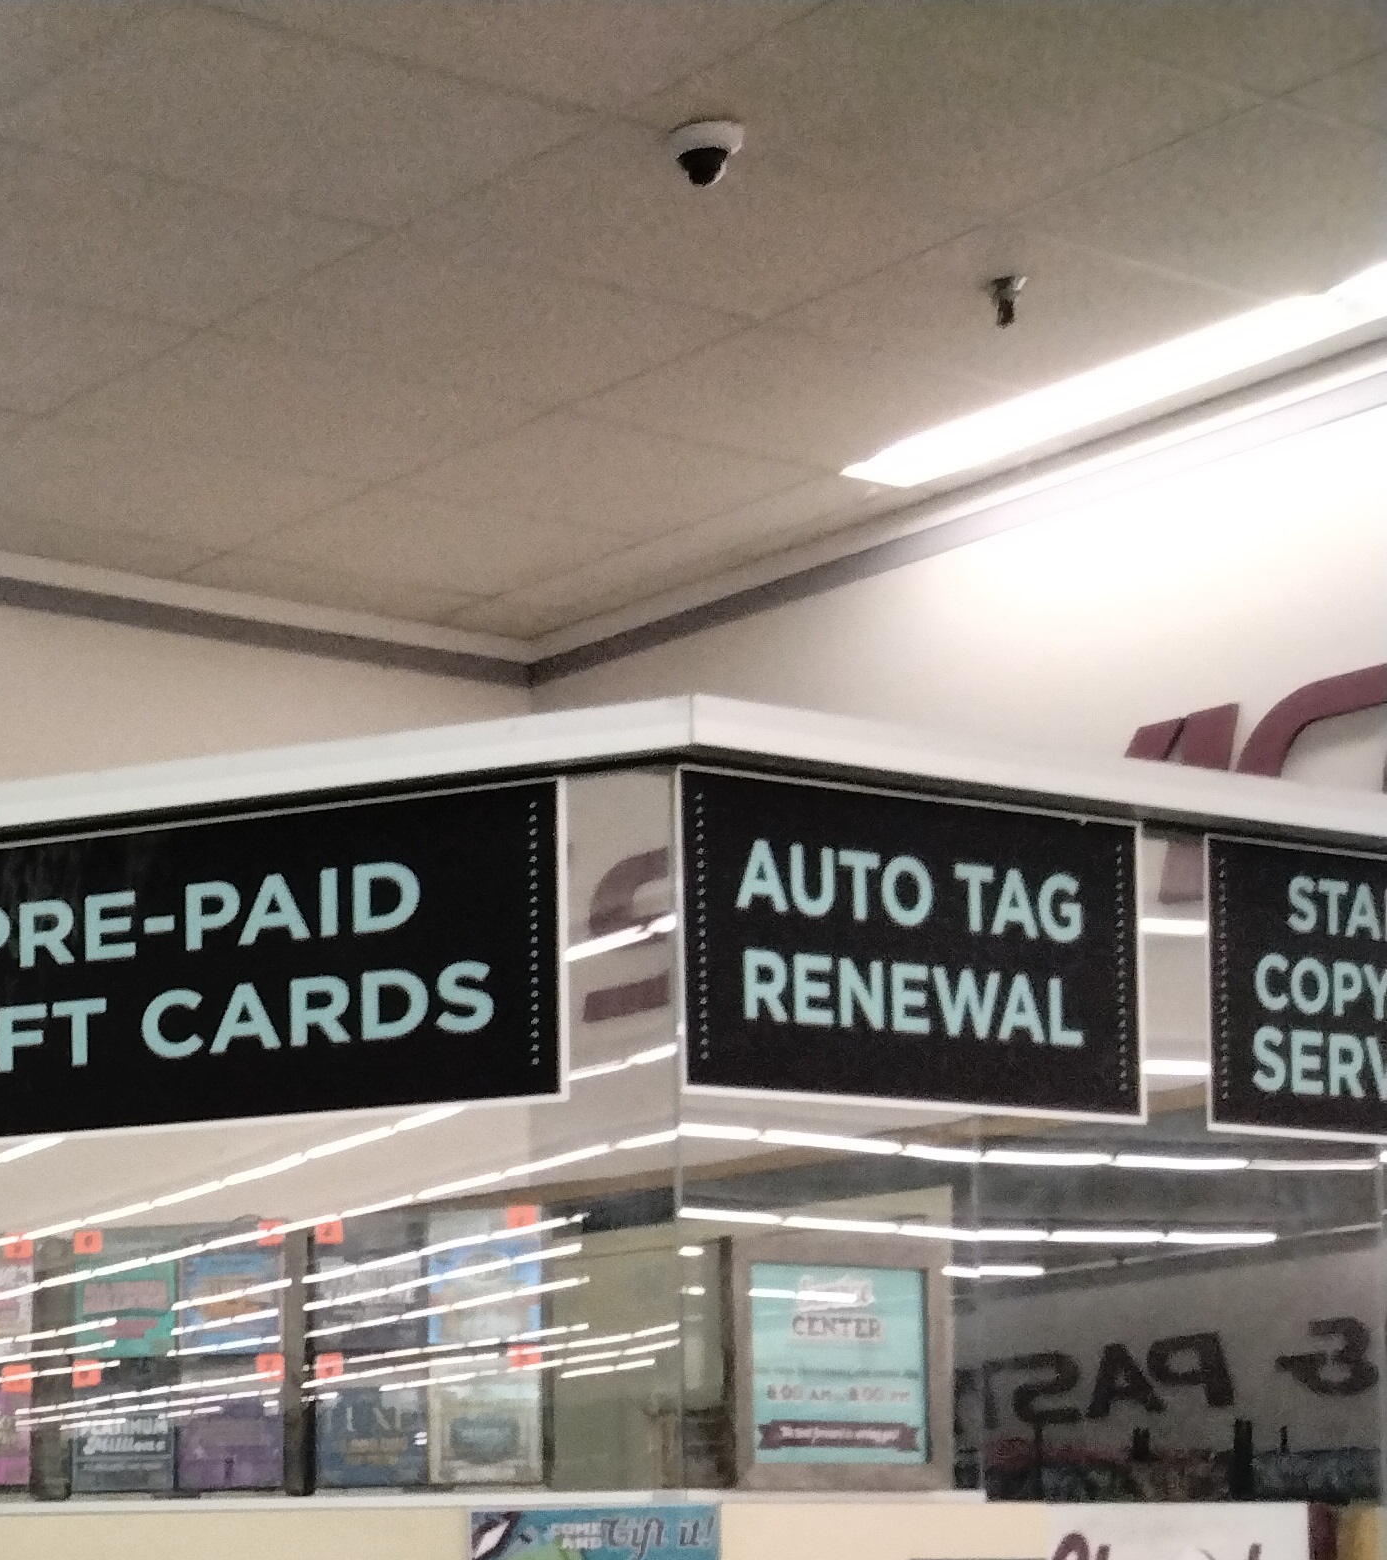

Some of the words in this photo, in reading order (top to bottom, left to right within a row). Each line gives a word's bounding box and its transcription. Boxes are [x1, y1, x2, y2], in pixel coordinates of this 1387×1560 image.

[736, 838, 935, 930] AUTO
[955, 863, 1084, 943] TAG
[1287, 875, 1387, 942] STA
[140, 959, 496, 1059] CARDS
[742, 949, 1085, 1049] RENEWAL
